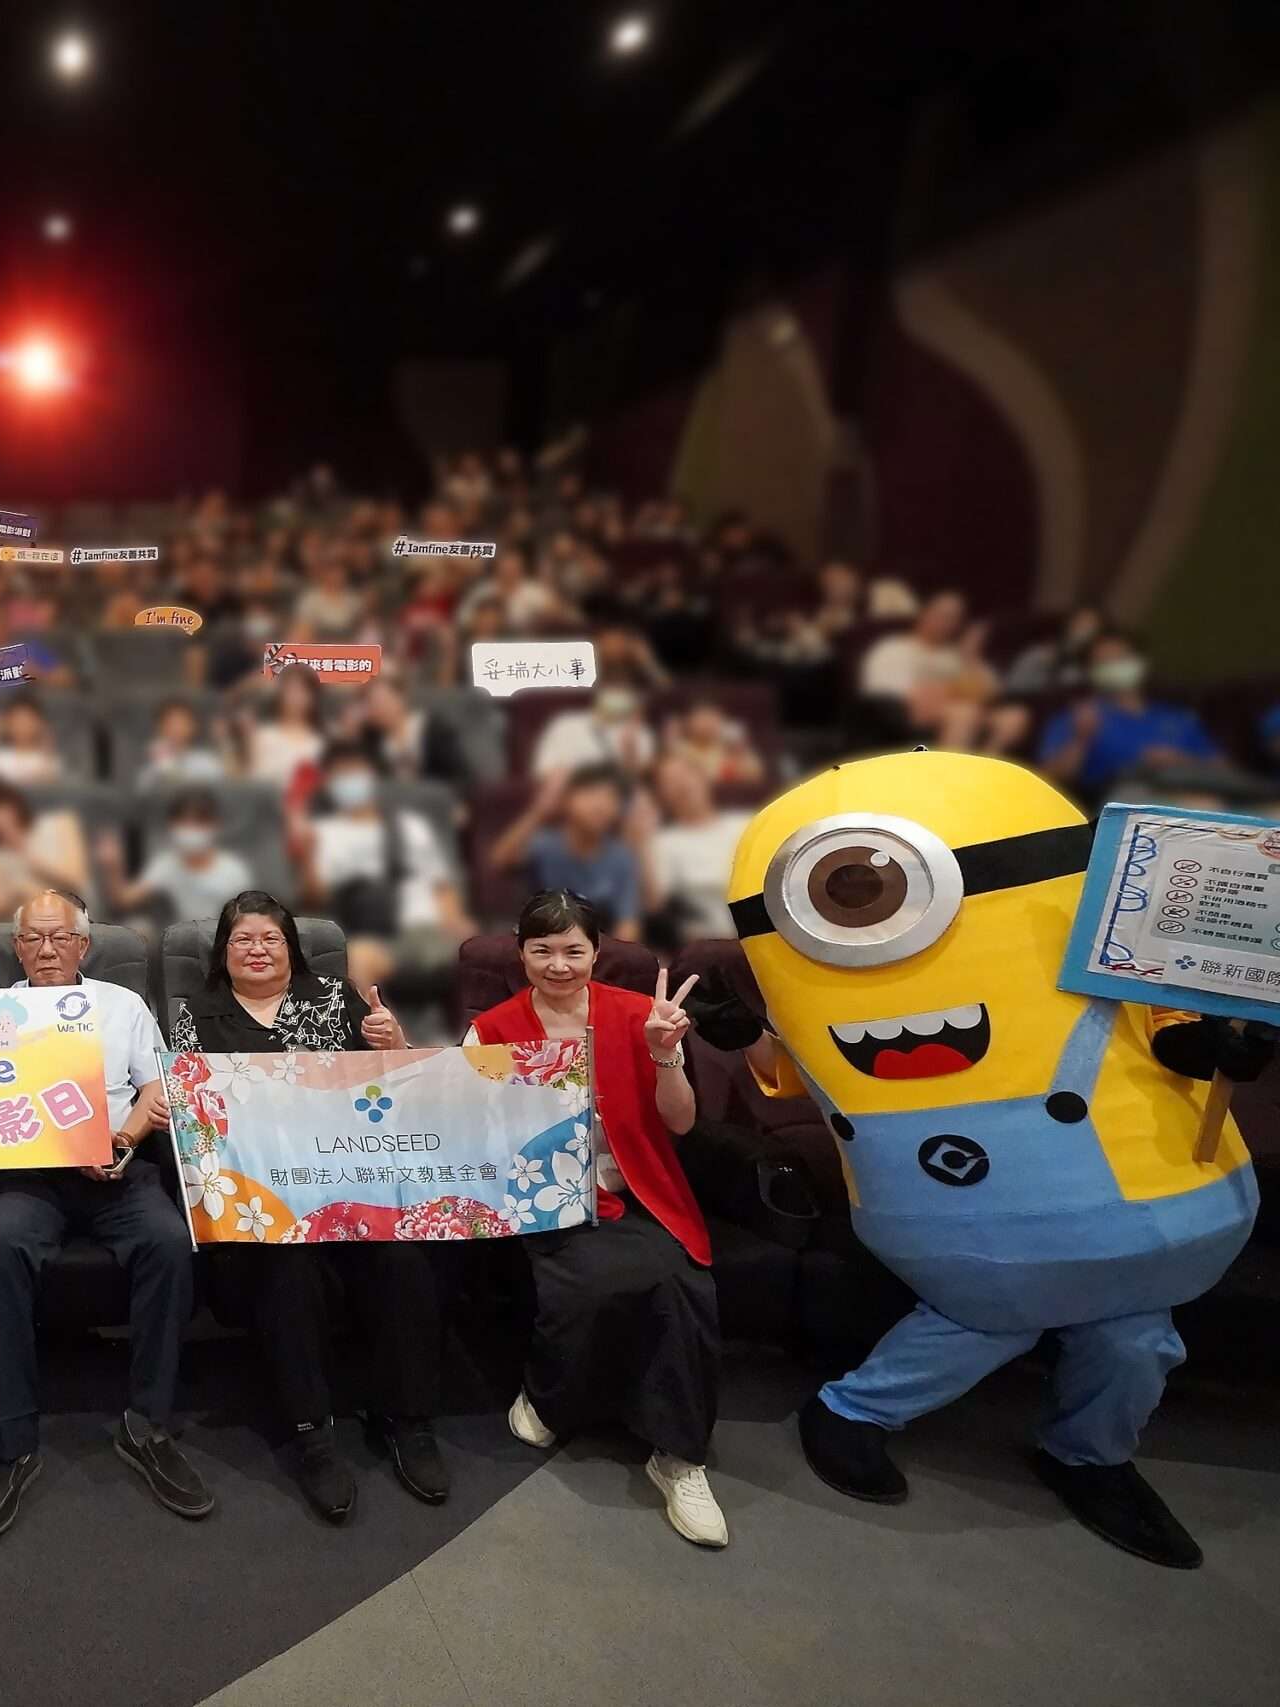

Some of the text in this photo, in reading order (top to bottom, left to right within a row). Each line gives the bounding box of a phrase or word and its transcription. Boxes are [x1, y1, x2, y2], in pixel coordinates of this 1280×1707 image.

[146, 610, 194, 625] I'm fine
[481, 658, 586, 681] 妥瑞大小事
[316, 1133, 441, 1154] LANDSEED
[270, 1162, 498, 1185] 財團法人聯新文教基金會
